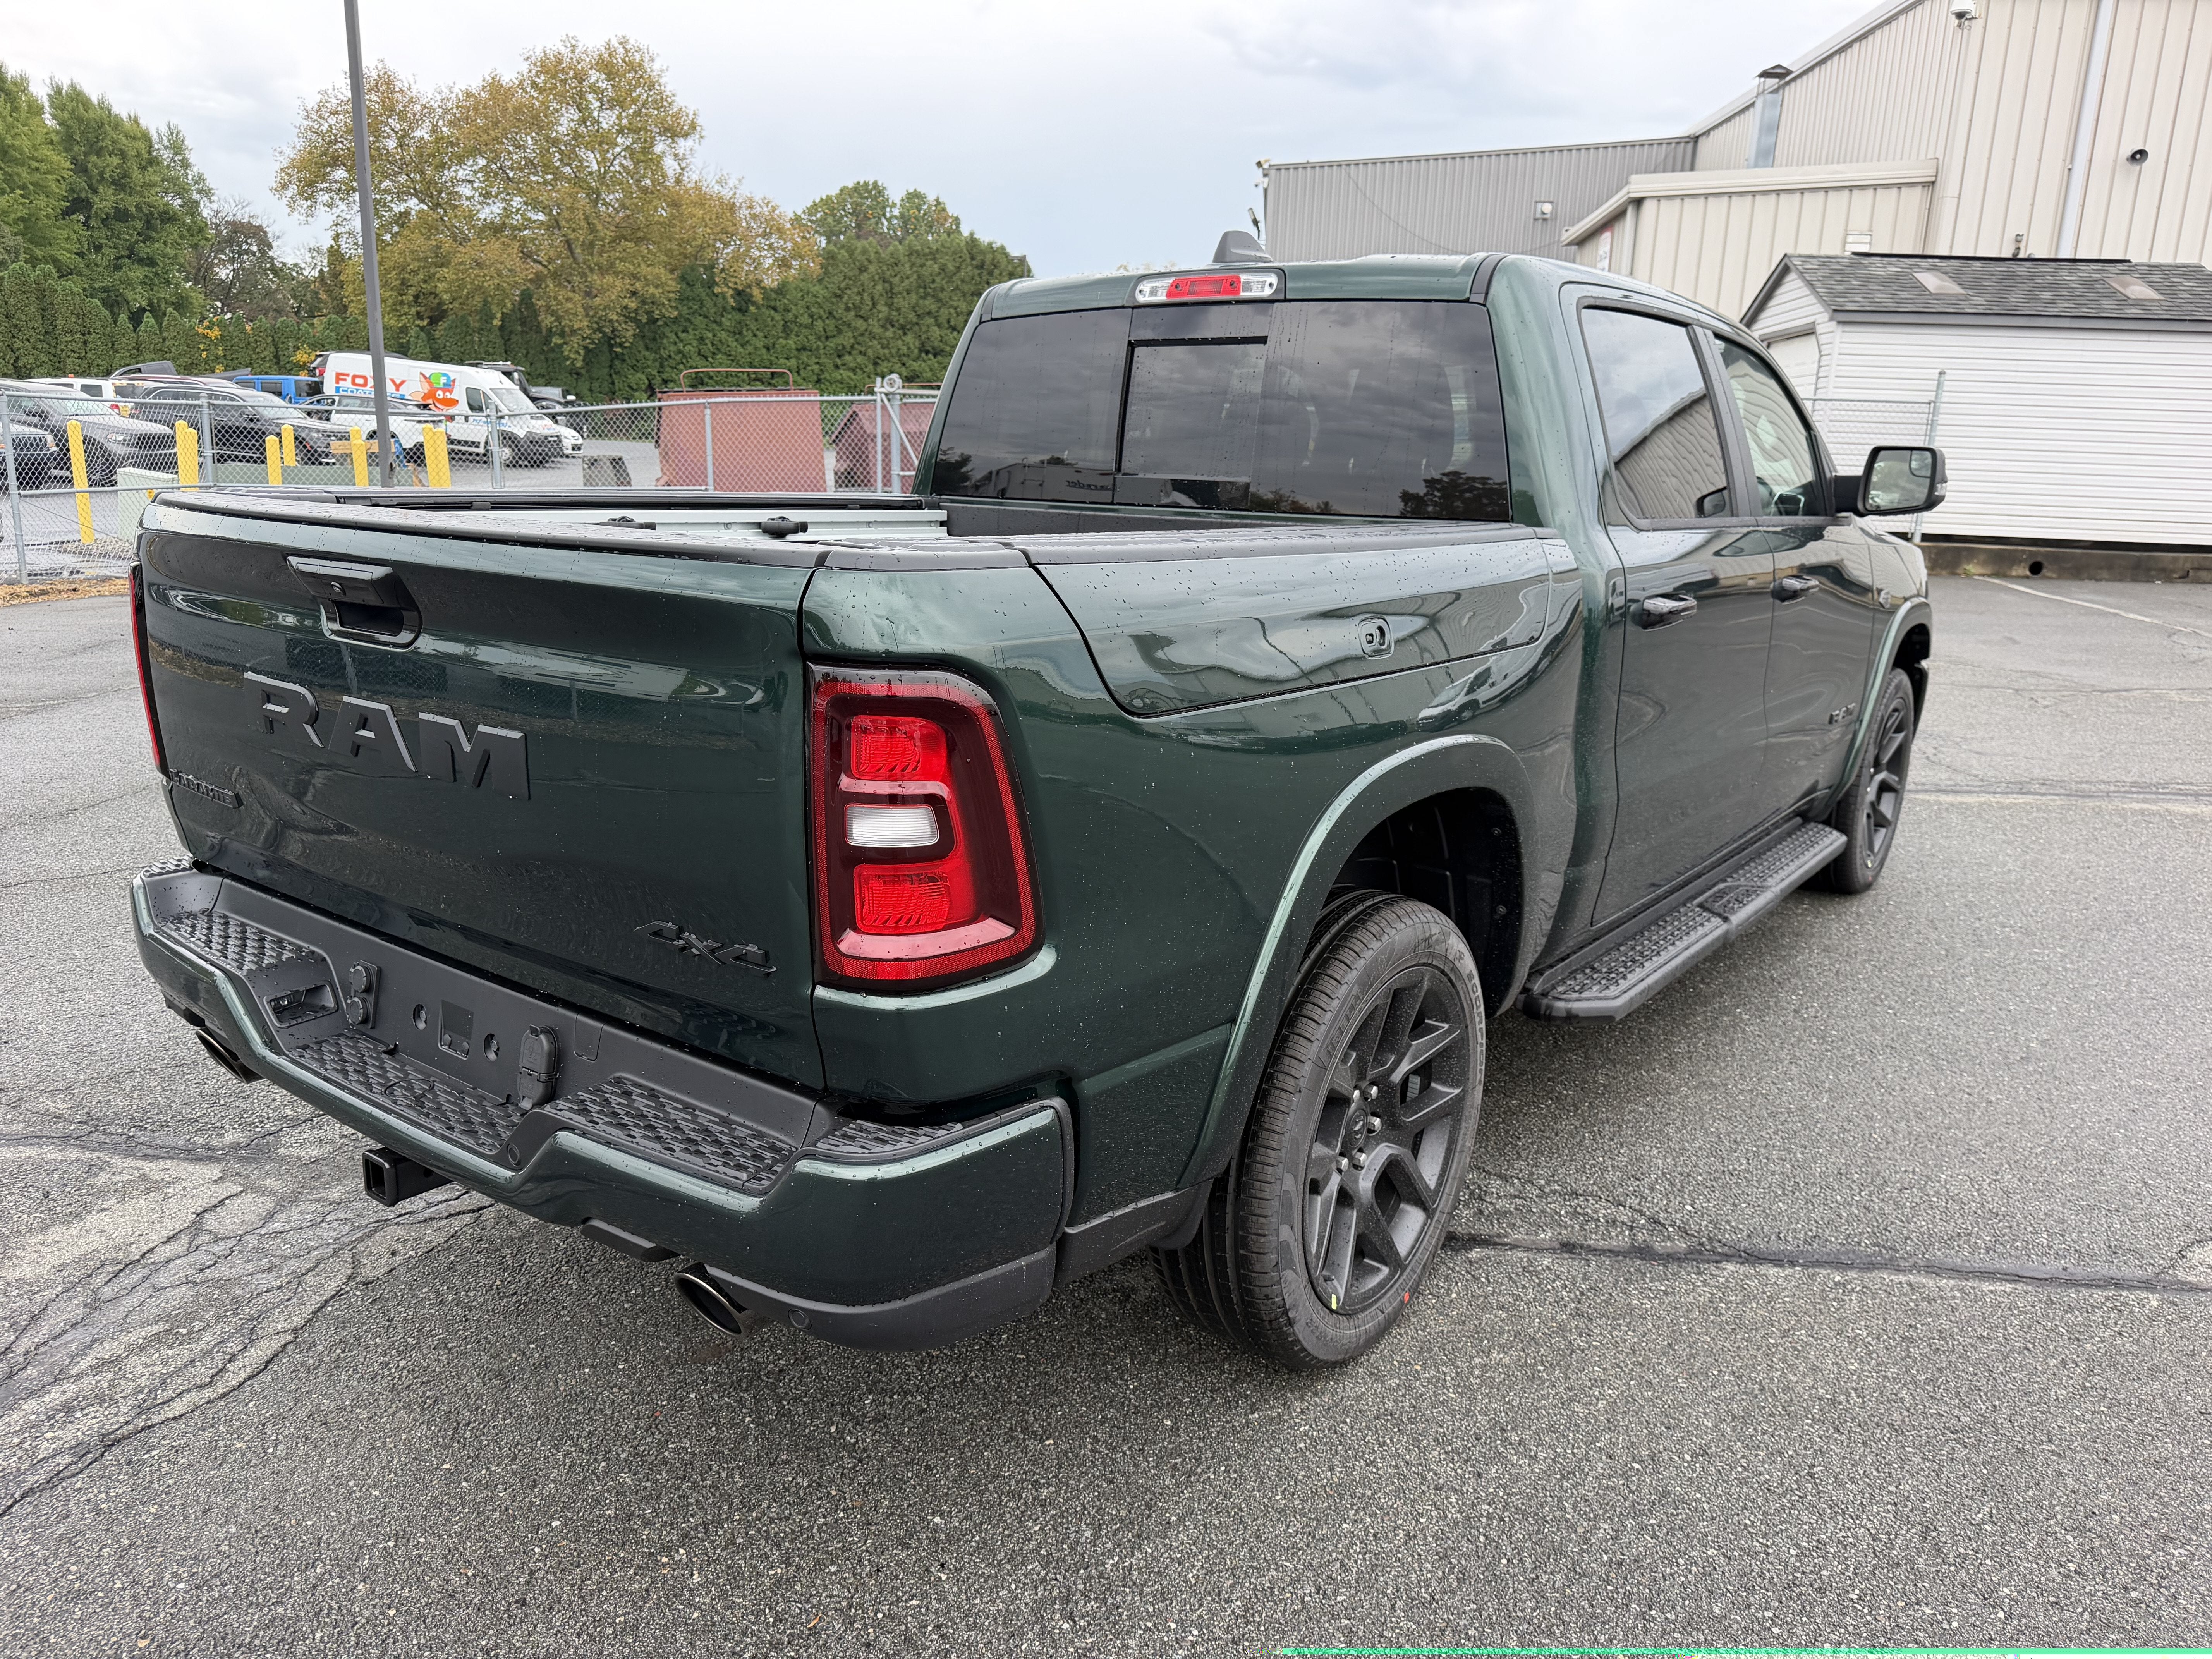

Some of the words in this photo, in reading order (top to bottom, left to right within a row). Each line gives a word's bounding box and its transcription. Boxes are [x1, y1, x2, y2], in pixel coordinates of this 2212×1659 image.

[335, 372, 408, 392] FOY
[440, 376, 447, 387] F
[244, 672, 531, 800] RAM
[169, 768, 237, 808] LARAMIE
[1467, 970, 1484, 1085] SCORPION
